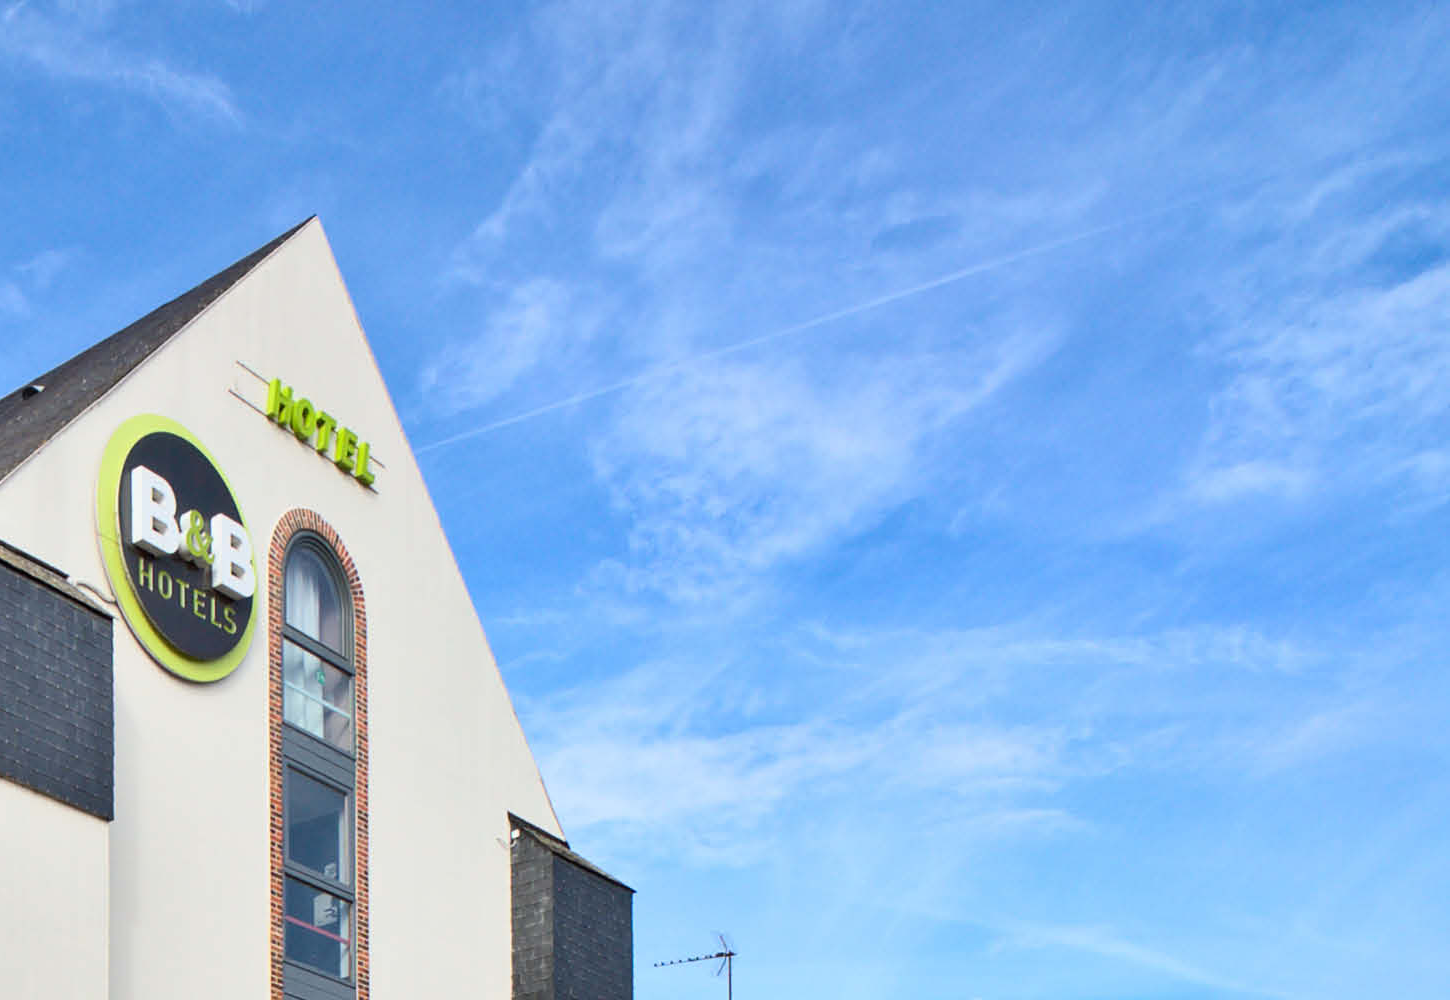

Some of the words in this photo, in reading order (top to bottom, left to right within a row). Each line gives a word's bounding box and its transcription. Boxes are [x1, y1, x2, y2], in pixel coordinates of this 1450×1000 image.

[267, 377, 375, 486] HOTEL
[131, 465, 256, 600] B&B
[138, 557, 237, 635] HOTELS
